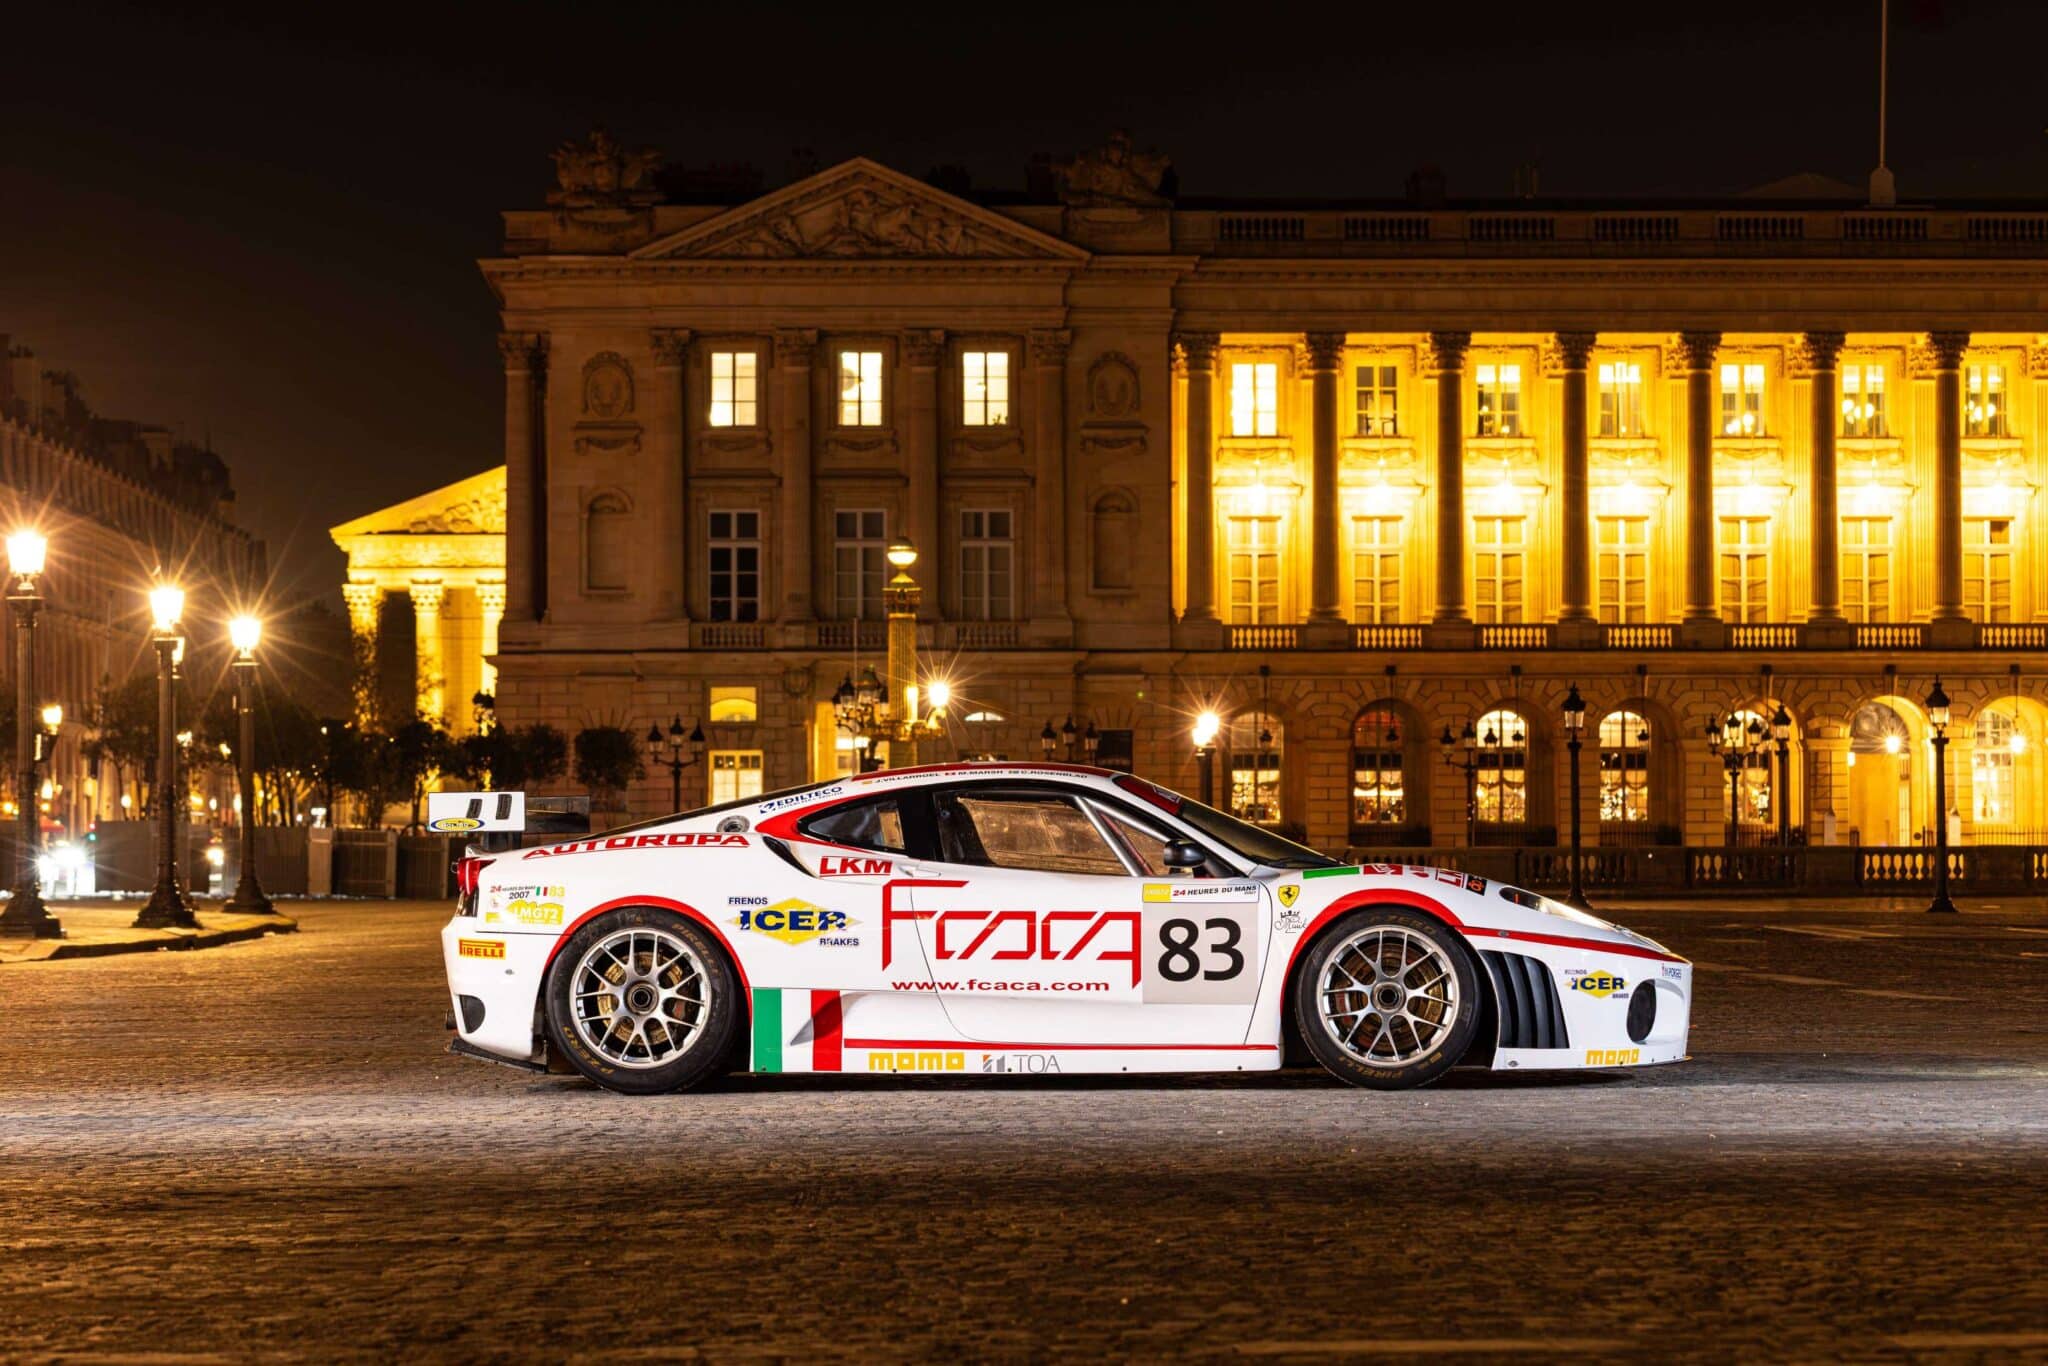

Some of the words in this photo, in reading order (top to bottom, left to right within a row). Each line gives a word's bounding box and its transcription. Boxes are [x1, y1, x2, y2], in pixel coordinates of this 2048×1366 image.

[777, 786, 843, 807] EDILTECO
[523, 833, 750, 860] AUTOROPA
[819, 858, 893, 875] LKM
[490, 885, 502, 893] 24
[508, 891, 530, 900] 2007
[549, 886, 566, 897] 83
[1173, 889, 1186, 897] 24
[1187, 887, 1219, 896] HEURES
[1234, 885, 1257, 893] MANS
[728, 897, 768, 905] FRENOS
[740, 910, 848, 931] ICER
[459, 939, 504, 958] PIRELLI
[819, 937, 859, 947] BRAKES
[1157, 917, 1245, 983] 83
[890, 978, 1110, 991] www.fcaca.com
[1571, 977, 1625, 990] ICER
[1012, 1054, 1061, 1073] TOA
